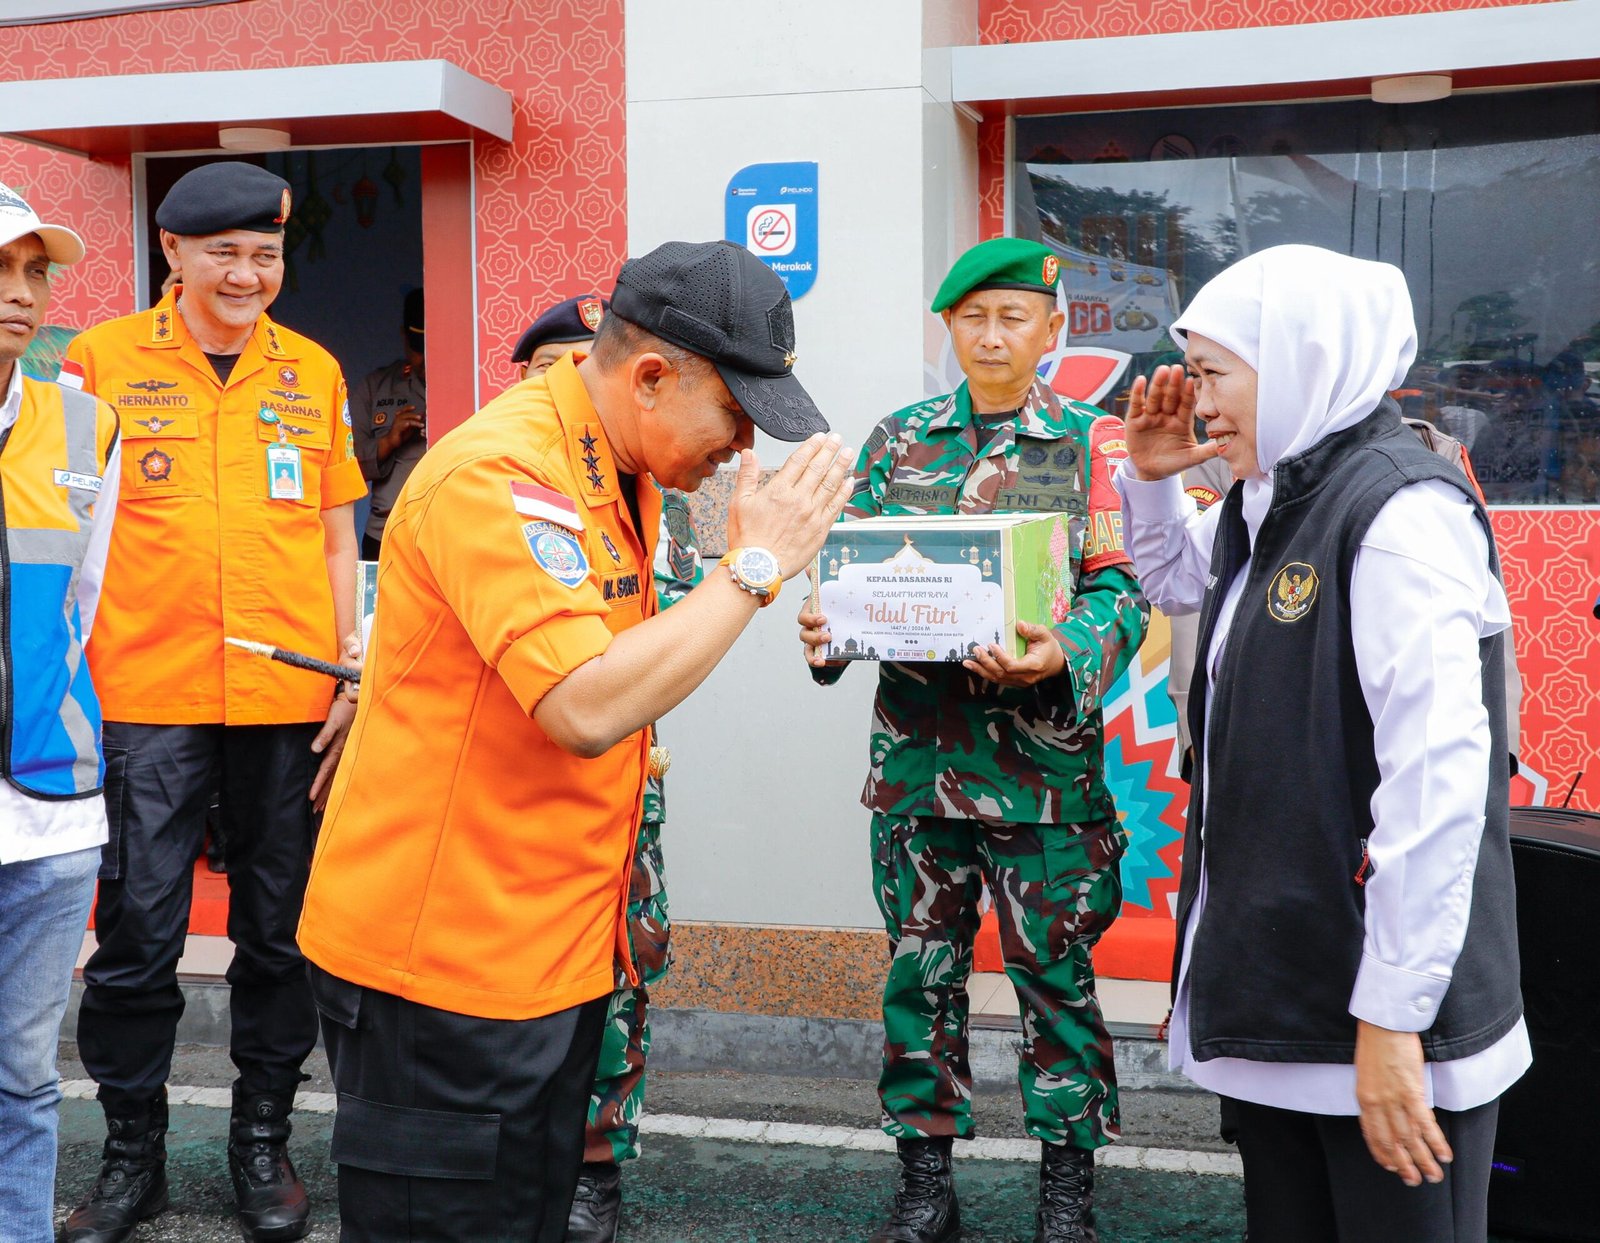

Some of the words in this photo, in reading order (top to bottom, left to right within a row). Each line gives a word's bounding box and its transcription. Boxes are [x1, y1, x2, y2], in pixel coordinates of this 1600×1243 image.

[771, 261, 812, 271] Merokok
[118, 394, 188, 407] HERNANTO
[260, 400, 322, 419] BASARNAS
[890, 488, 949, 502] SUTRISNO
[1004, 494, 1039, 506] TNI
[1050, 495, 1080, 510] AD
[525, 522, 575, 539] BASARNAS
[866, 575, 897, 583] KEPALA
[872, 590, 906, 598] SELAMAT
[906, 590, 927, 599] HARI
[927, 591, 949, 599] RAYA
[864, 602, 908, 624] Idul
[911, 605, 959, 625] Fitri
